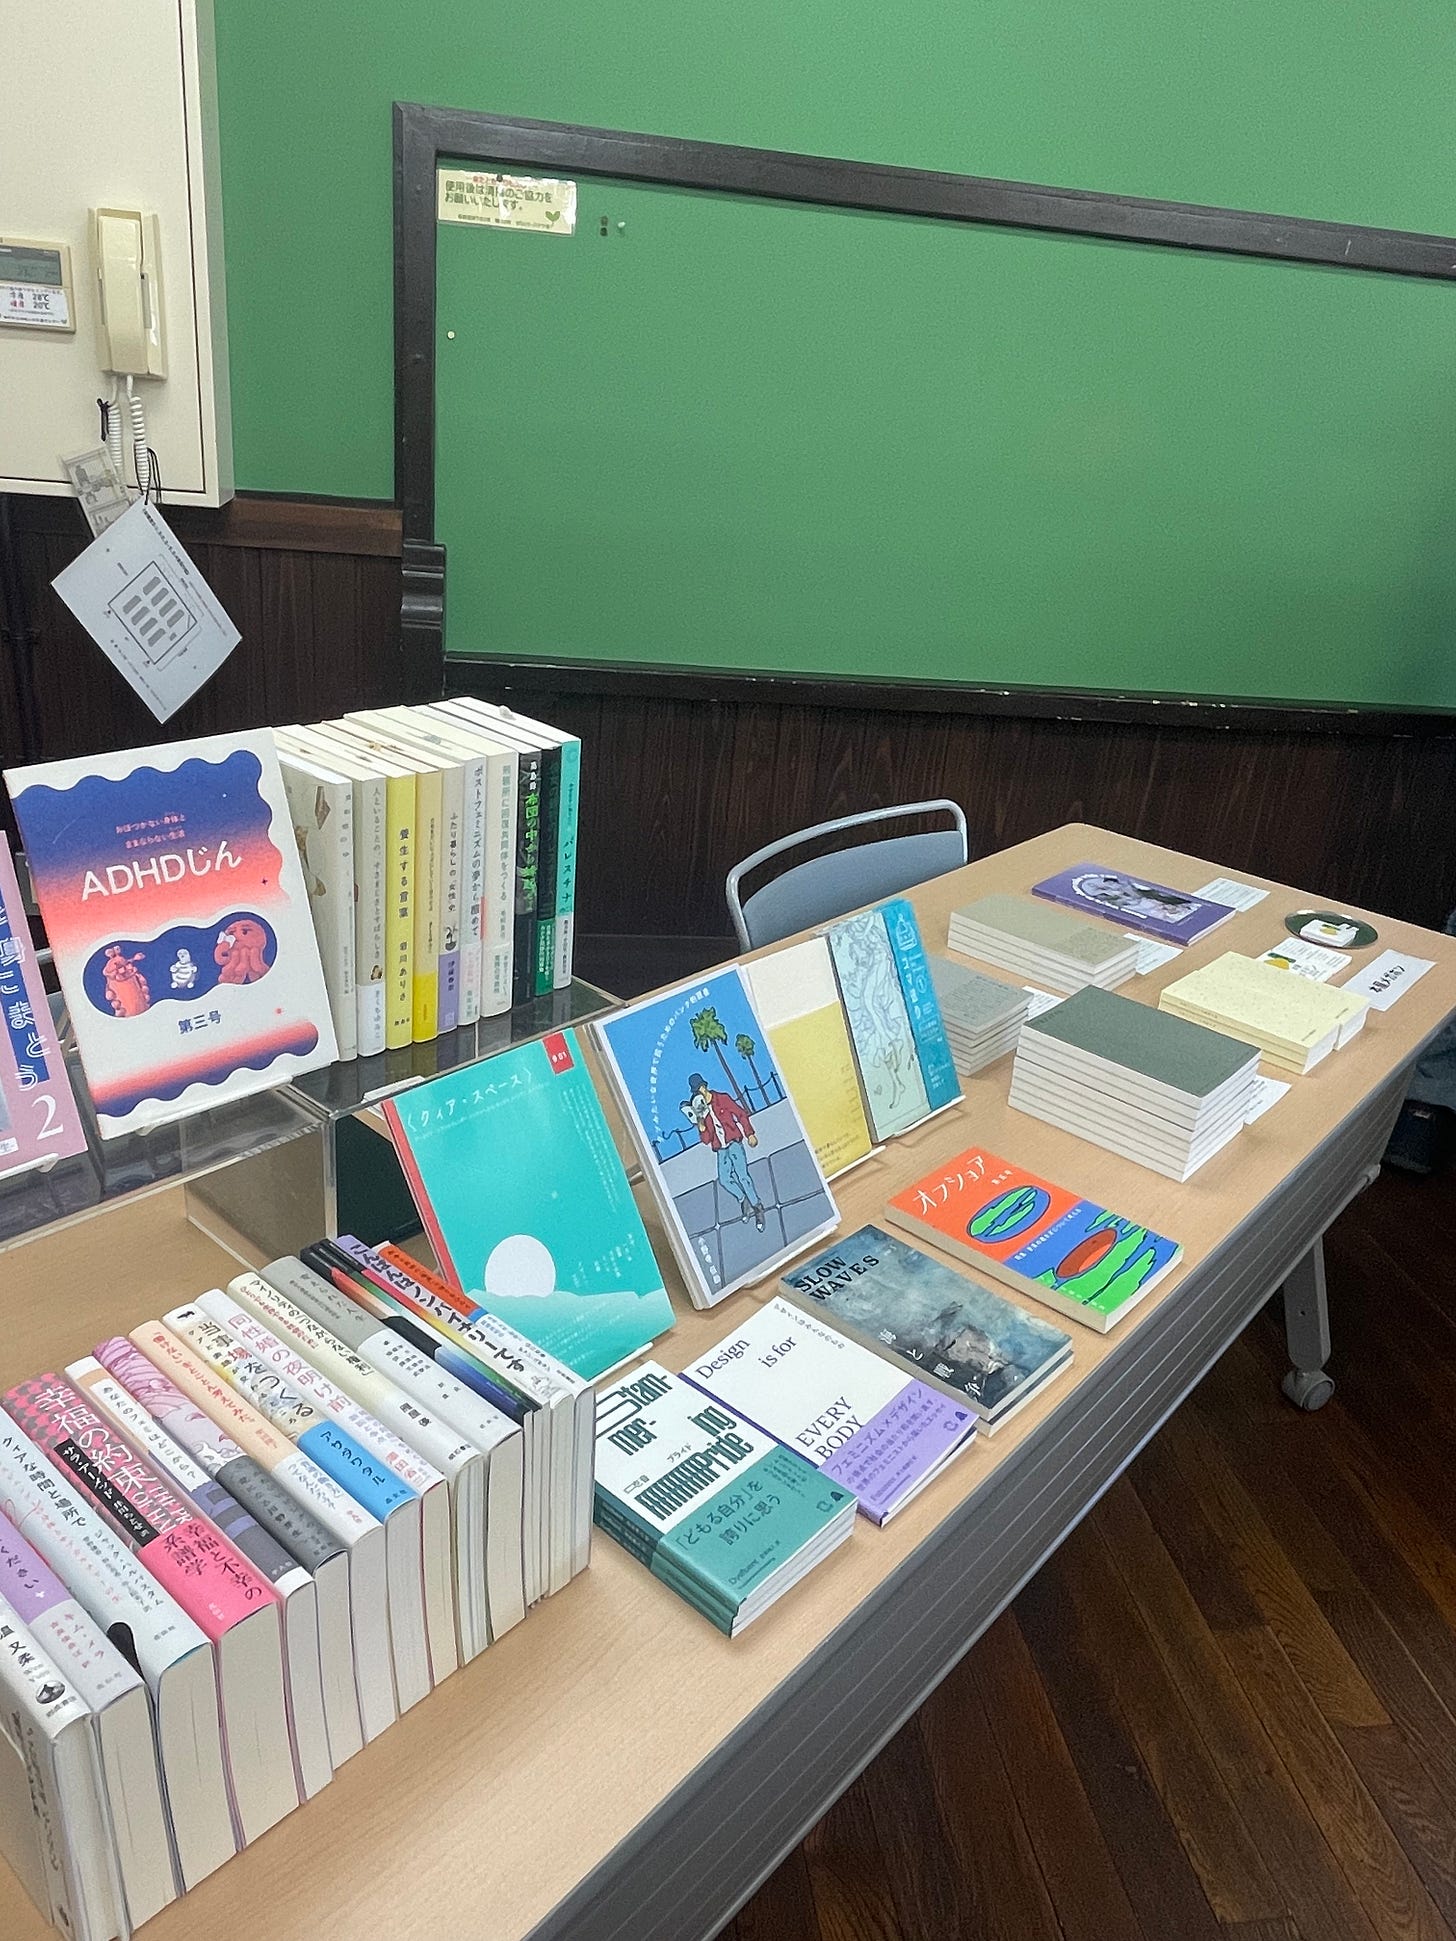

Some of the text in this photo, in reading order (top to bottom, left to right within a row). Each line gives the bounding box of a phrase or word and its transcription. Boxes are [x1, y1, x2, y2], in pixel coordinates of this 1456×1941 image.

[81, 840, 242, 902] ADHDじん
[399, 828, 409, 918] 養生する言葉
[178, 1010, 222, 1036] 第三号
[31, 1094, 64, 1141] 2
[912, 1155, 985, 1216] オフショア
[796, 1255, 845, 1293] SLOW
[810, 1254, 880, 1302] WAVES
[249, 1279, 375, 1377] マイノリティの「つながらない権利」
[198, 1321, 314, 1417] 当事場をつくる
[228, 1314, 352, 1413] 同性婚の夜明け前
[694, 1336, 798, 1379] Design is for
[34, 1385, 158, 1496] 幸福の約束
[795, 1396, 852, 1447] EVERY
[814, 1415, 864, 1460] BODY
[832, 1388, 923, 1475] フェミニズム×デザイン
[320, 1430, 386, 1487] アサダワタル
[719, 1494, 781, 1546] 誇りに思う
[164, 1533, 207, 1576] 系譜学
[184, 1523, 262, 1600] 幸福と不幸の
